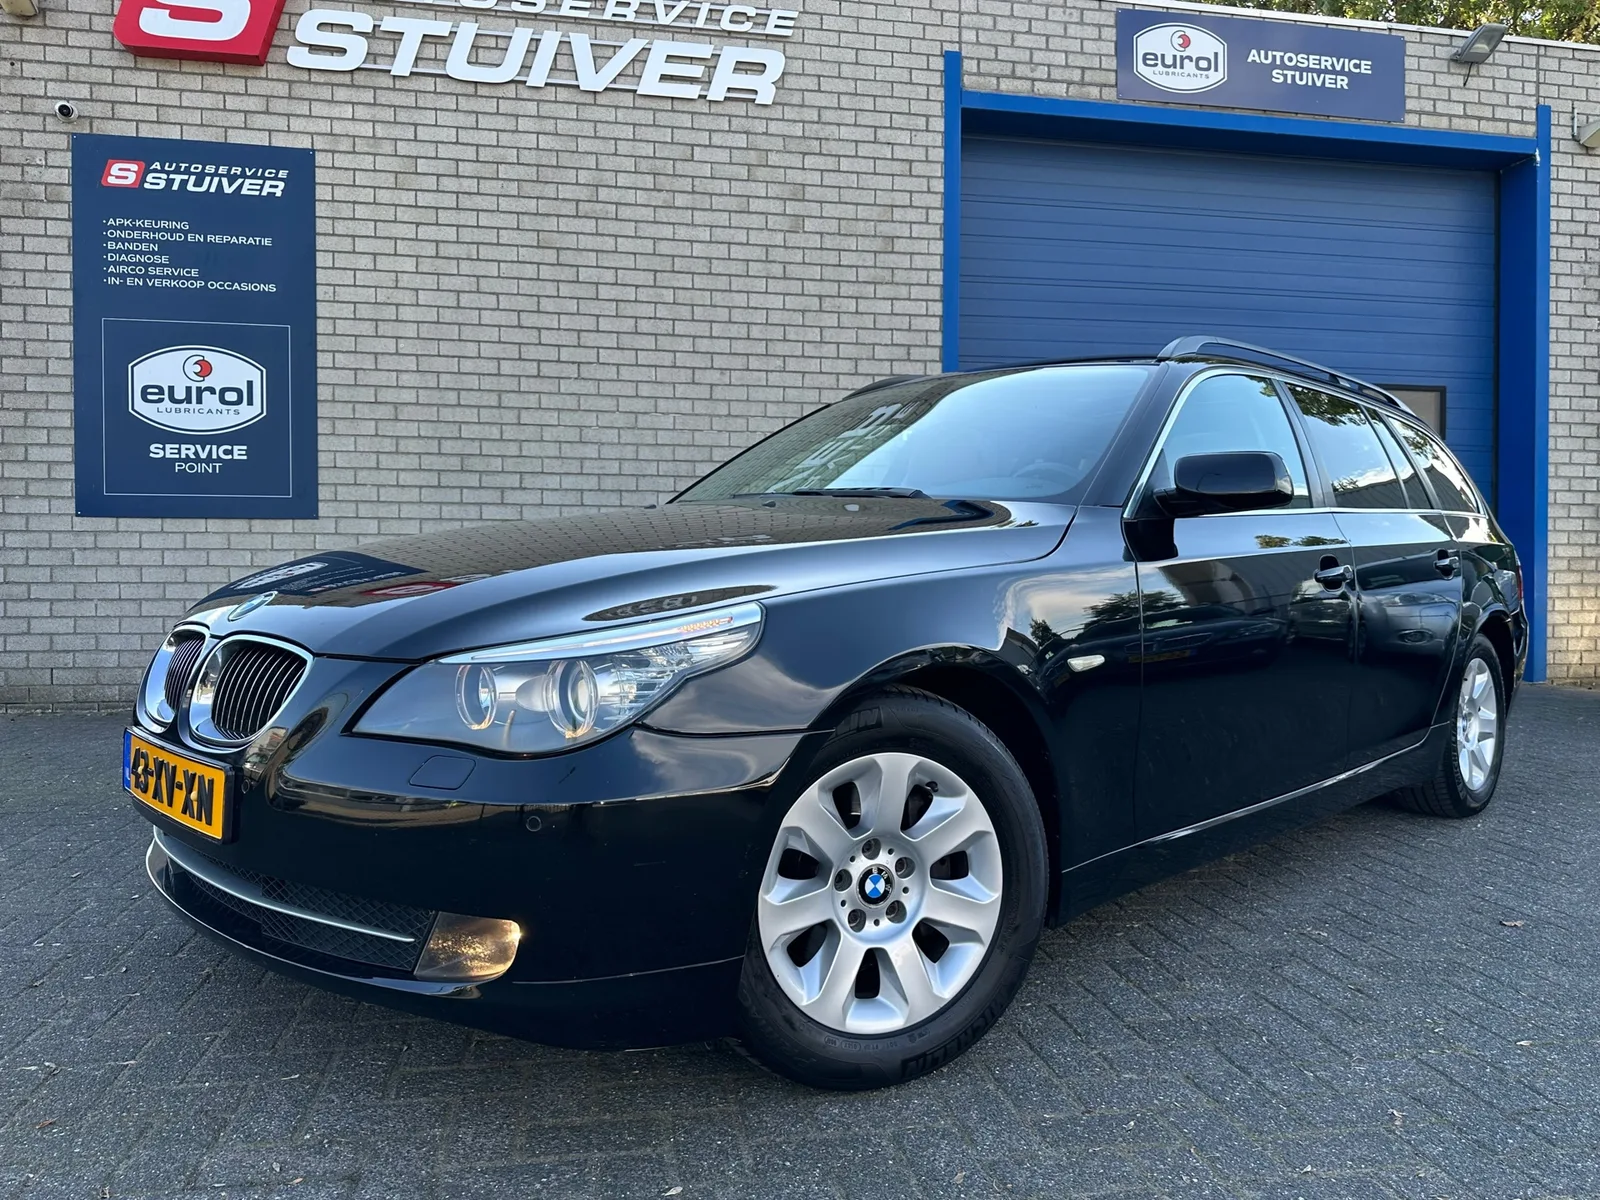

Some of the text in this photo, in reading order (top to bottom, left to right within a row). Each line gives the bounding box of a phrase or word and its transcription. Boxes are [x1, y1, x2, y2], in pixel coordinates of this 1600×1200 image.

[286, 9, 786, 105] STUIVER
[1141, 51, 1219, 73] eurol
[1247, 48, 1372, 75] AUTOSERVICE
[1152, 69, 1210, 80] LUBRICANTS
[1271, 69, 1349, 90] STUIVER
[149, 161, 289, 179] AUTOSERVICE
[143, 173, 285, 198] STUIVER
[107, 217, 190, 231] APK-KEURING
[107, 229, 273, 247] ONDERHOUD EN REPARATIE
[107, 241, 159, 252] BANDEN
[107, 253, 170, 265] DIAGNOSE
[107, 265, 199, 277] AIRCO SERVICE
[107, 276, 277, 293] IN- EN VERKOOP OCCASIONS
[140, 380, 254, 406] eurol
[156, 407, 240, 416] LUBRICANTS
[149, 443, 248, 460] SERVICE
[175, 462, 223, 474] POINT
[131, 746, 215, 827] 43-XV-XN
